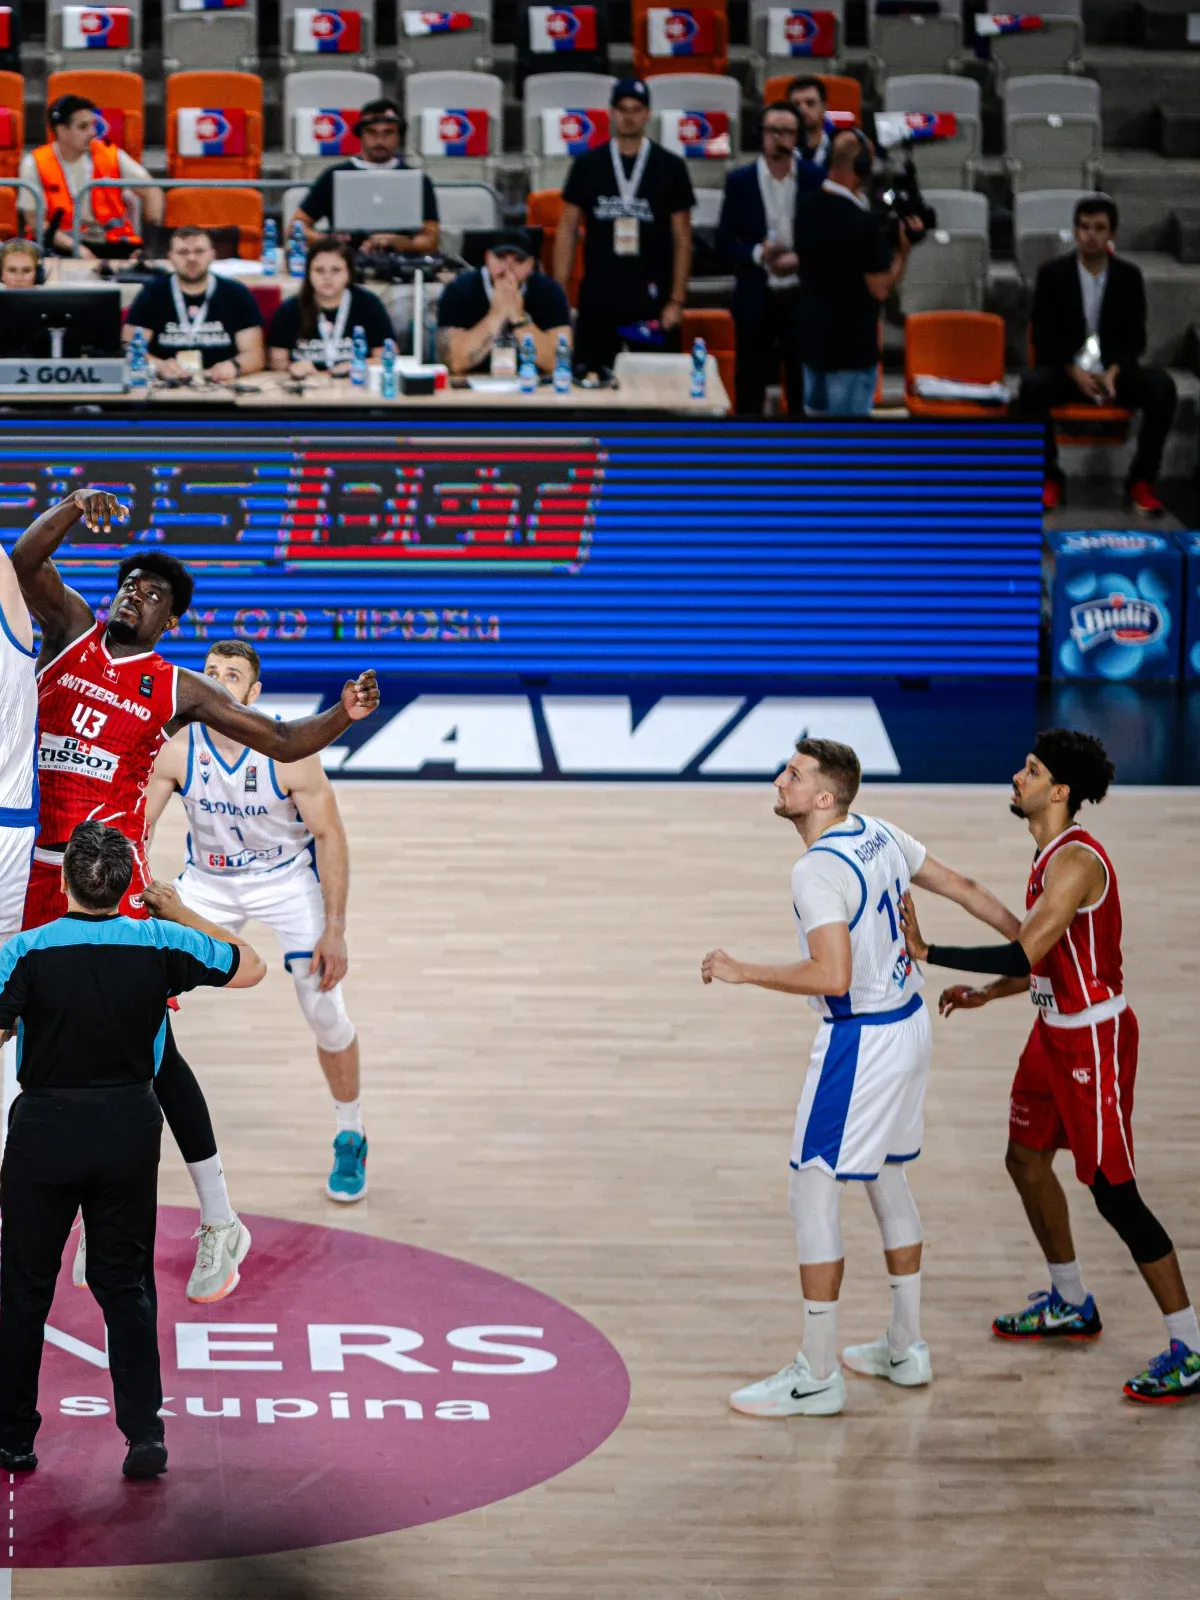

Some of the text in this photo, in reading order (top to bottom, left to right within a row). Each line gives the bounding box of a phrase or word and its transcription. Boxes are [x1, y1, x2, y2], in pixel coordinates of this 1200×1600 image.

[36, 366, 102, 384] GOAL
[232, 607, 308, 641] OD
[71, 703, 109, 739] 43
[40, 747, 114, 771] TISSOT
[58, 1391, 491, 1424] supina
